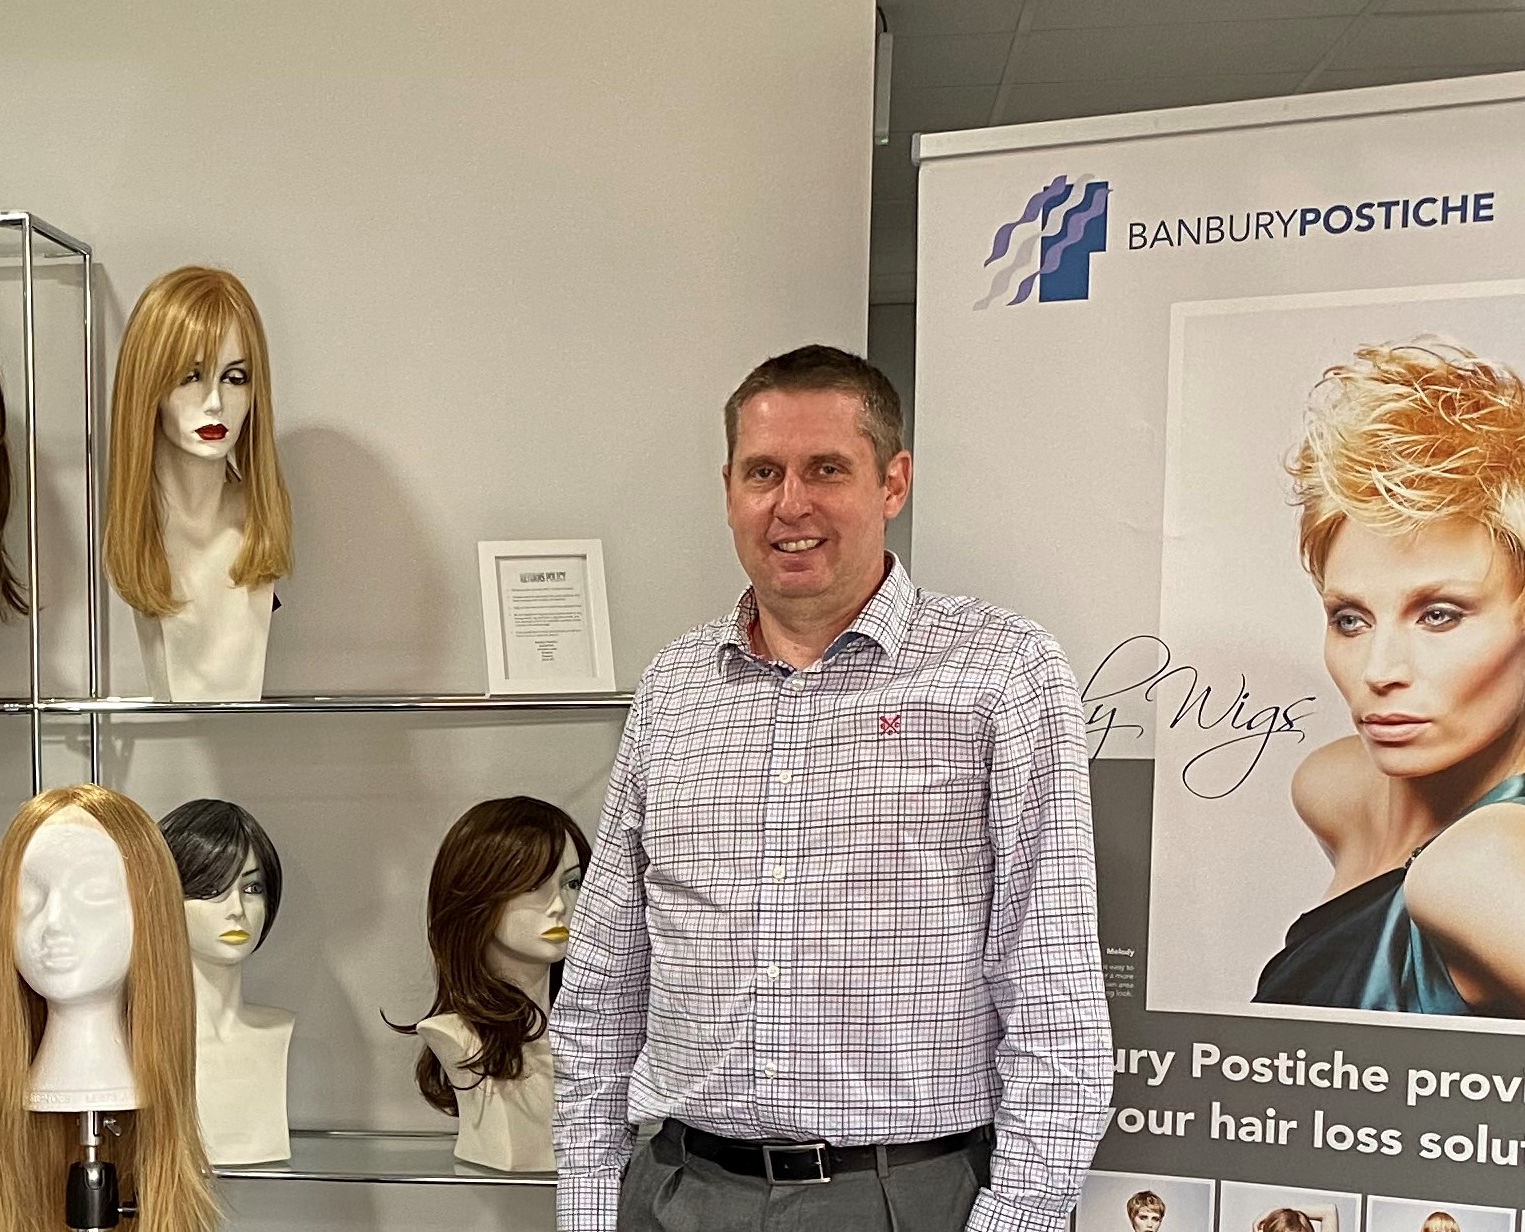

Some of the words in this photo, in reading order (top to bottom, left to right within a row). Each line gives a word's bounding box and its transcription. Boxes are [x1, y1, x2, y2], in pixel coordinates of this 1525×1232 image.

[1128, 192, 1495, 250] BANBURYPOSTICHE
[1145, 666, 1316, 799] Wigs
[1192, 1042, 1389, 1093] Postiche
[1407, 1069, 1525, 1106] prov
[1210, 1101, 1298, 1145] hair
[1313, 1110, 1403, 1156] loss
[1419, 1124, 1525, 1166] solu
